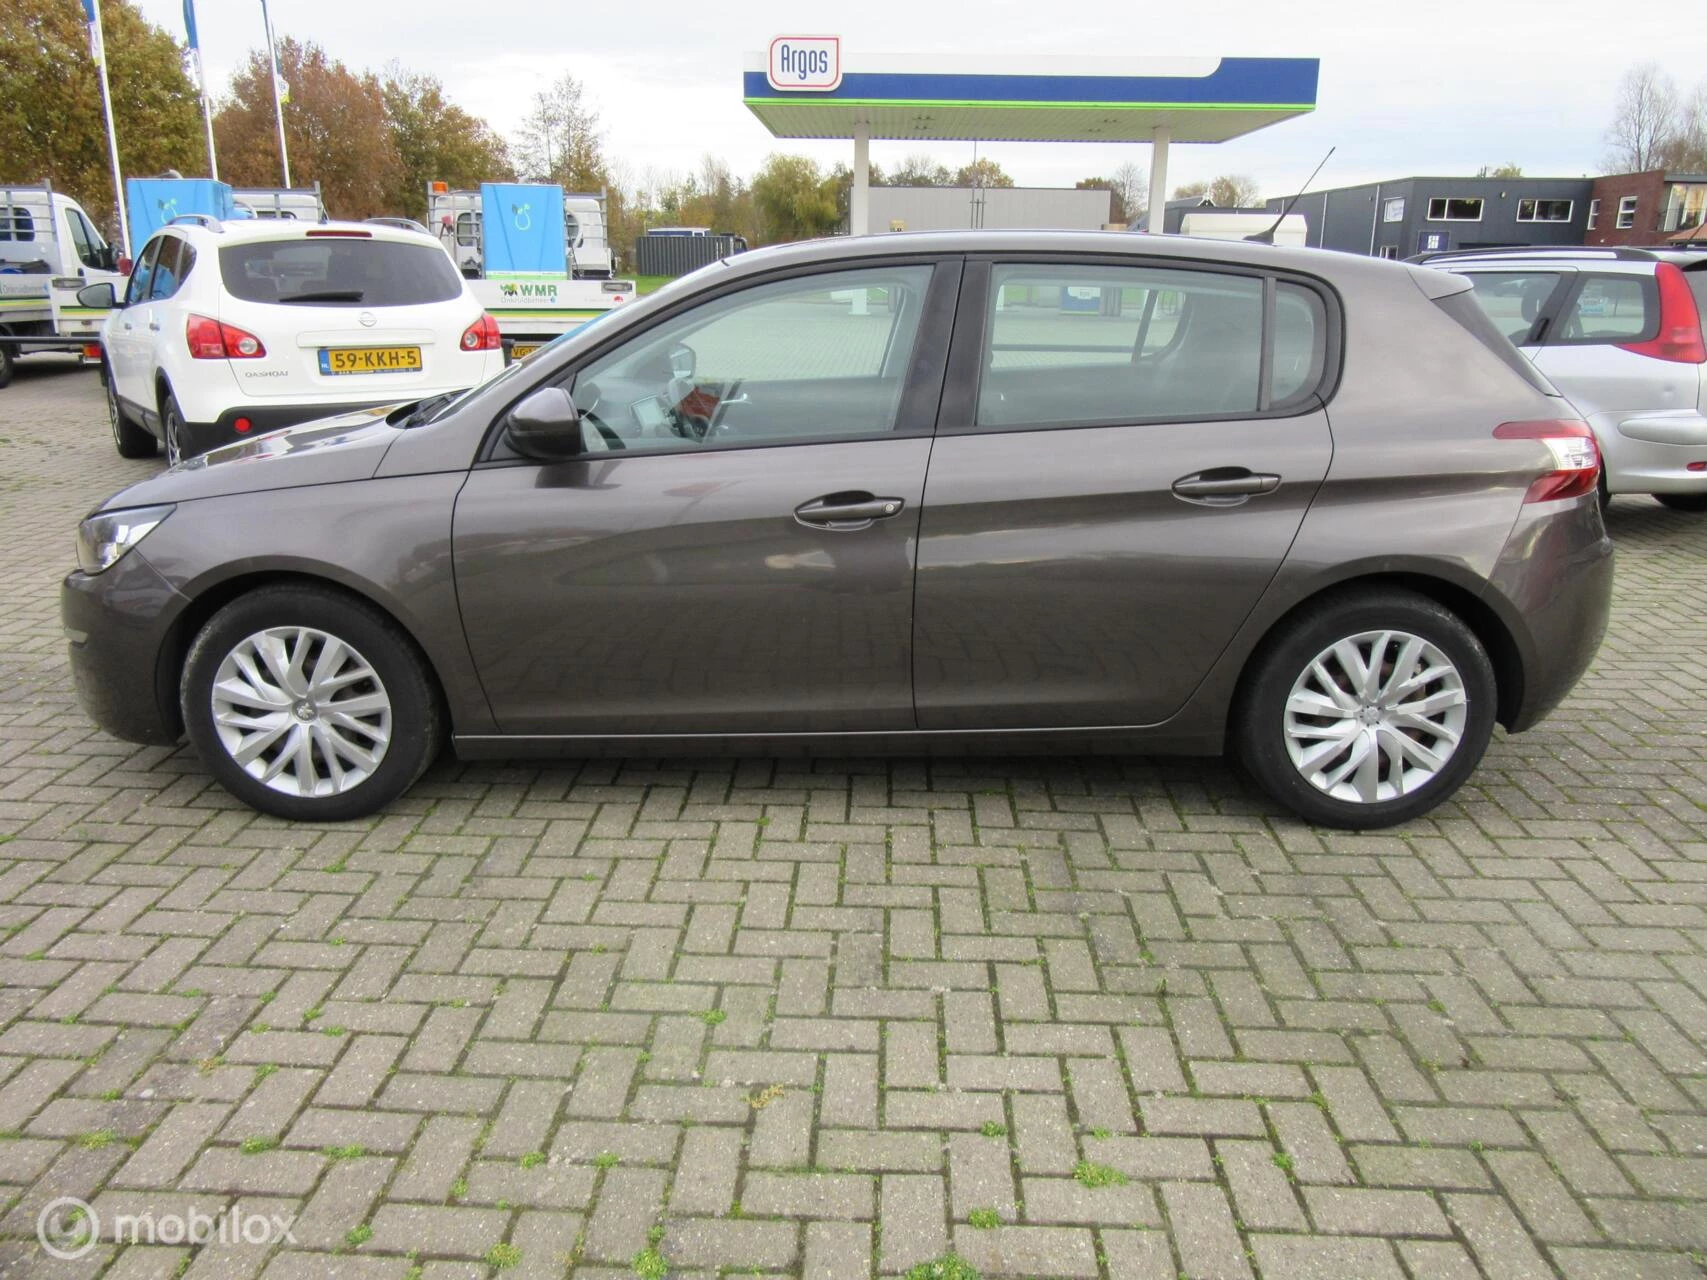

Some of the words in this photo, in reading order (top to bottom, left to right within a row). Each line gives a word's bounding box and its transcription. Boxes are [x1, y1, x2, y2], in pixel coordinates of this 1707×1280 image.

[781, 44, 828, 80] Argos
[520, 284, 558, 296] WMR
[335, 350, 417, 369] 59-KKH-5
